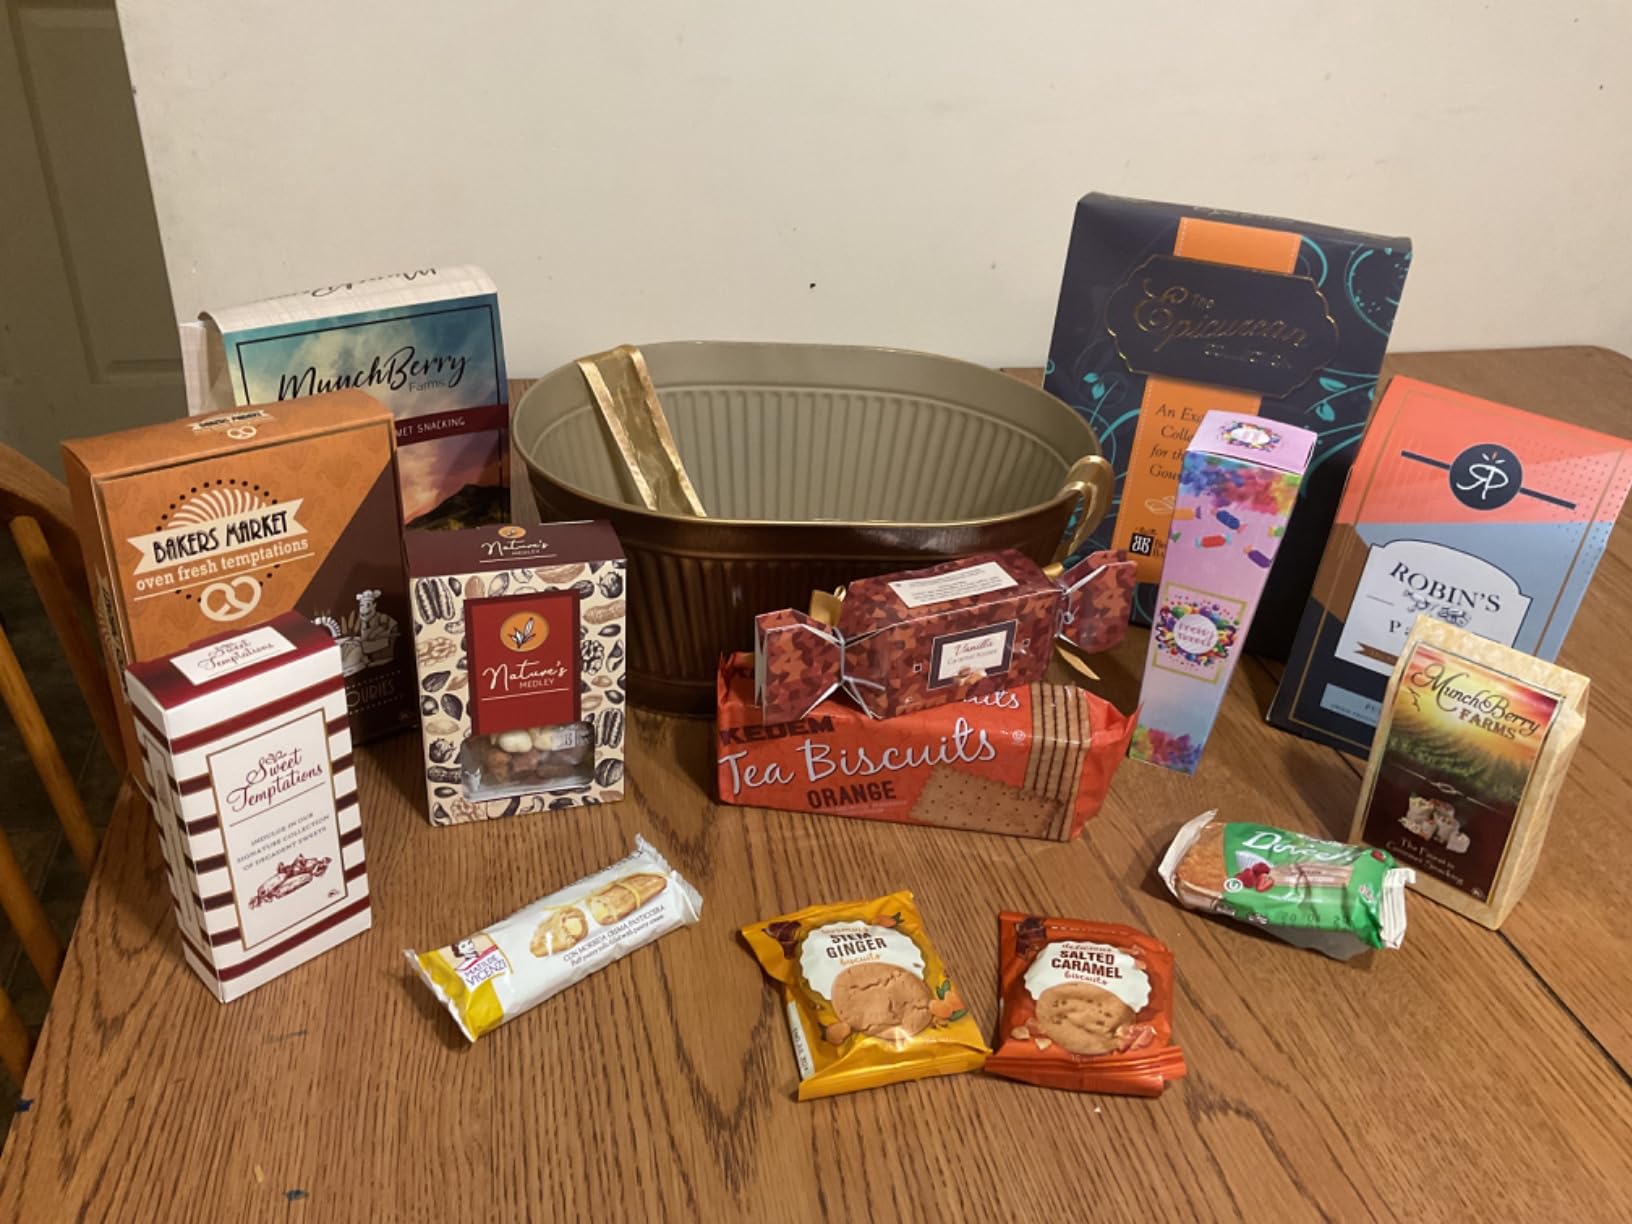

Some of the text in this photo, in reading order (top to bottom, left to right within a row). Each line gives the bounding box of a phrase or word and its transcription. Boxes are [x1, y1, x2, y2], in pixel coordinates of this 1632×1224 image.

[277, 346, 472, 400] MunchBerry
[409, 378, 447, 393] Farms
[417, 416, 466, 434] SNACKING
[1155, 404, 1176, 417] An
[1150, 444, 1168, 458] for
[152, 510, 289, 564] BAKERS MARKET
[135, 536, 309, 592] oven fresh temptations
[1390, 561, 1502, 614] ROBIN'S
[481, 659, 568, 691] Nature's
[519, 677, 555, 689] MEDLEY
[1410, 663, 1542, 737] MunchBerry
[720, 716, 835, 746] KEDEM
[1459, 709, 1517, 741] FARMS
[246, 747, 303, 786] Sweet
[718, 717, 998, 795] Tea Biscuits
[226, 764, 323, 812] Temptations
[807, 780, 897, 809] ORANGE
[826, 938, 888, 959] GINGER
[1060, 950, 1114, 965] SALTED
[466, 959, 508, 987] VICENZI
[1051, 957, 1123, 979] CARAMEL
